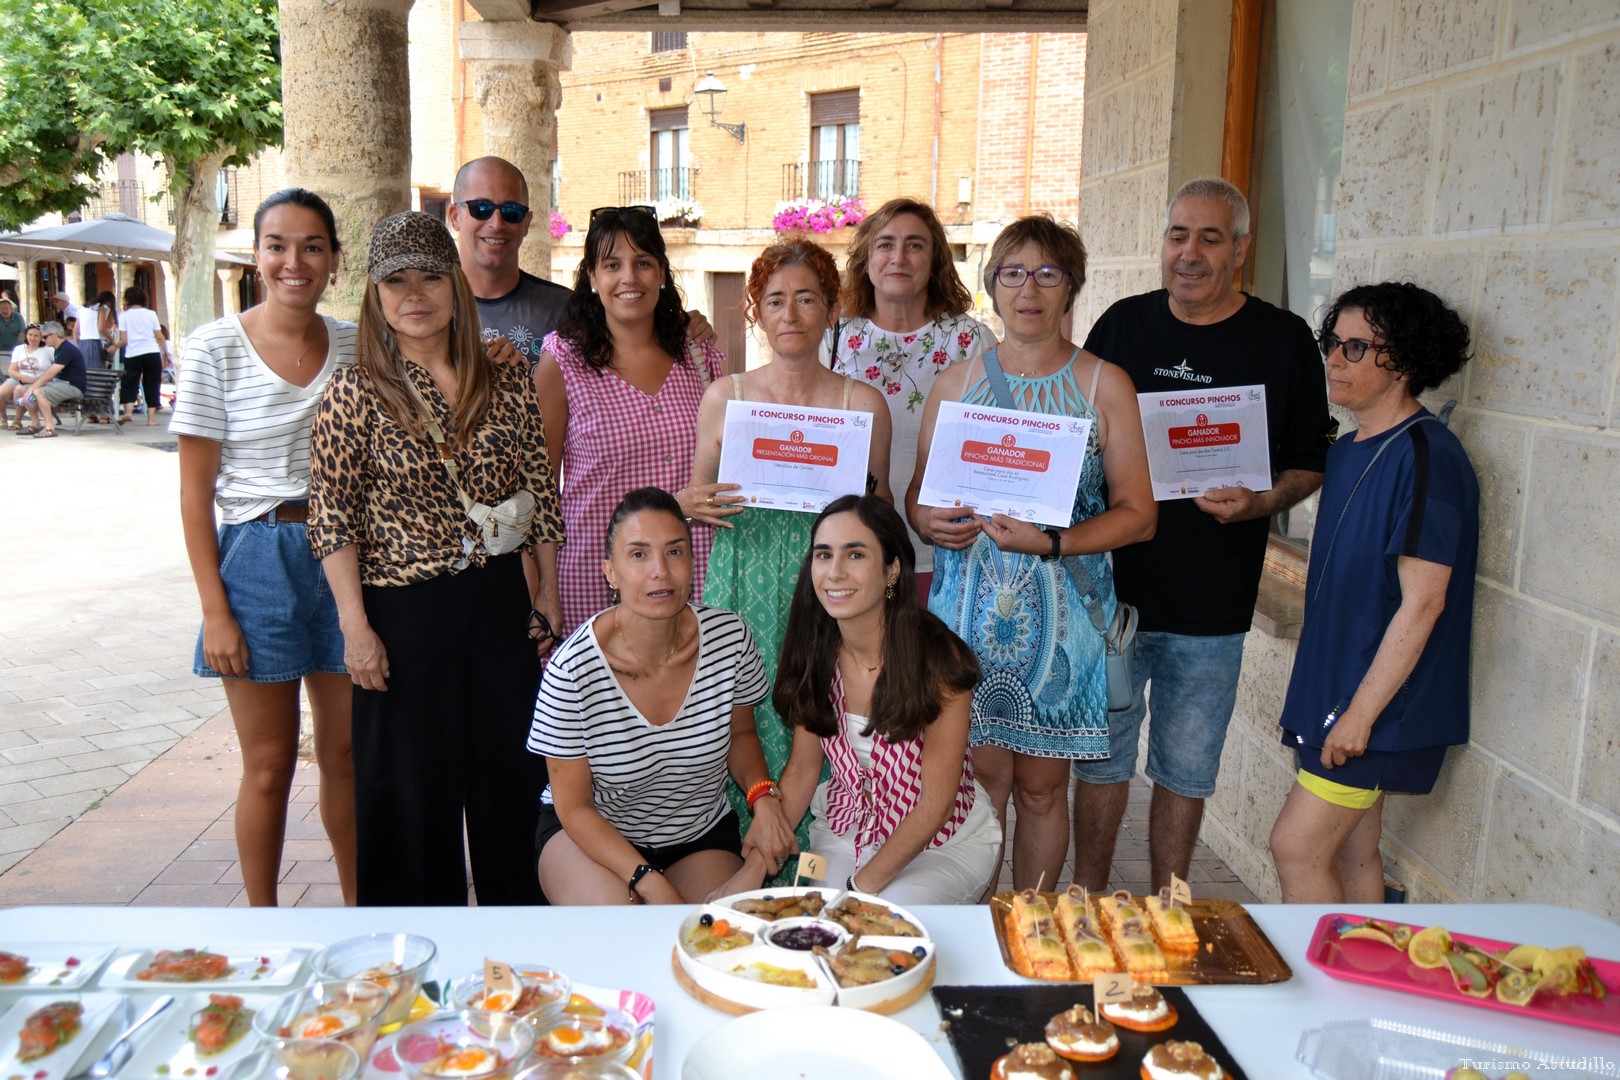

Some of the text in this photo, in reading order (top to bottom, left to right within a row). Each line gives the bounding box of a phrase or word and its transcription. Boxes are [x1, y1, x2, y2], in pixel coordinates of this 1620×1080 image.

[1153, 367, 1212, 384] STONE ISLAND
[1165, 397, 1206, 407] CONCURSO
[1207, 394, 1241, 404] PINCHOS
[758, 409, 805, 421] CONCURSO
[807, 415, 845, 425] PINCHOS
[963, 411, 970, 419] II
[971, 412, 1020, 425] CONCURSO
[1021, 419, 1061, 431] PINCHOS
[1172, 437, 1193, 445] PINCHO
[1203, 434, 1238, 443] INNOVADOR
[1187, 427, 1220, 437] GANADOR
[756, 448, 796, 459] PRESENTACIÓN
[808, 454, 834, 463] ORIGINAL
[779, 444, 812, 454] GANADOR
[986, 446, 1026, 459] GANADOR
[963, 451, 1046, 469] PINCHO MÁS TRADICIONAL
[807, 858, 817, 875] 4
[1175, 883, 1187, 898] 1
[492, 965, 504, 980] 5
[1105, 980, 1126, 997] 2
